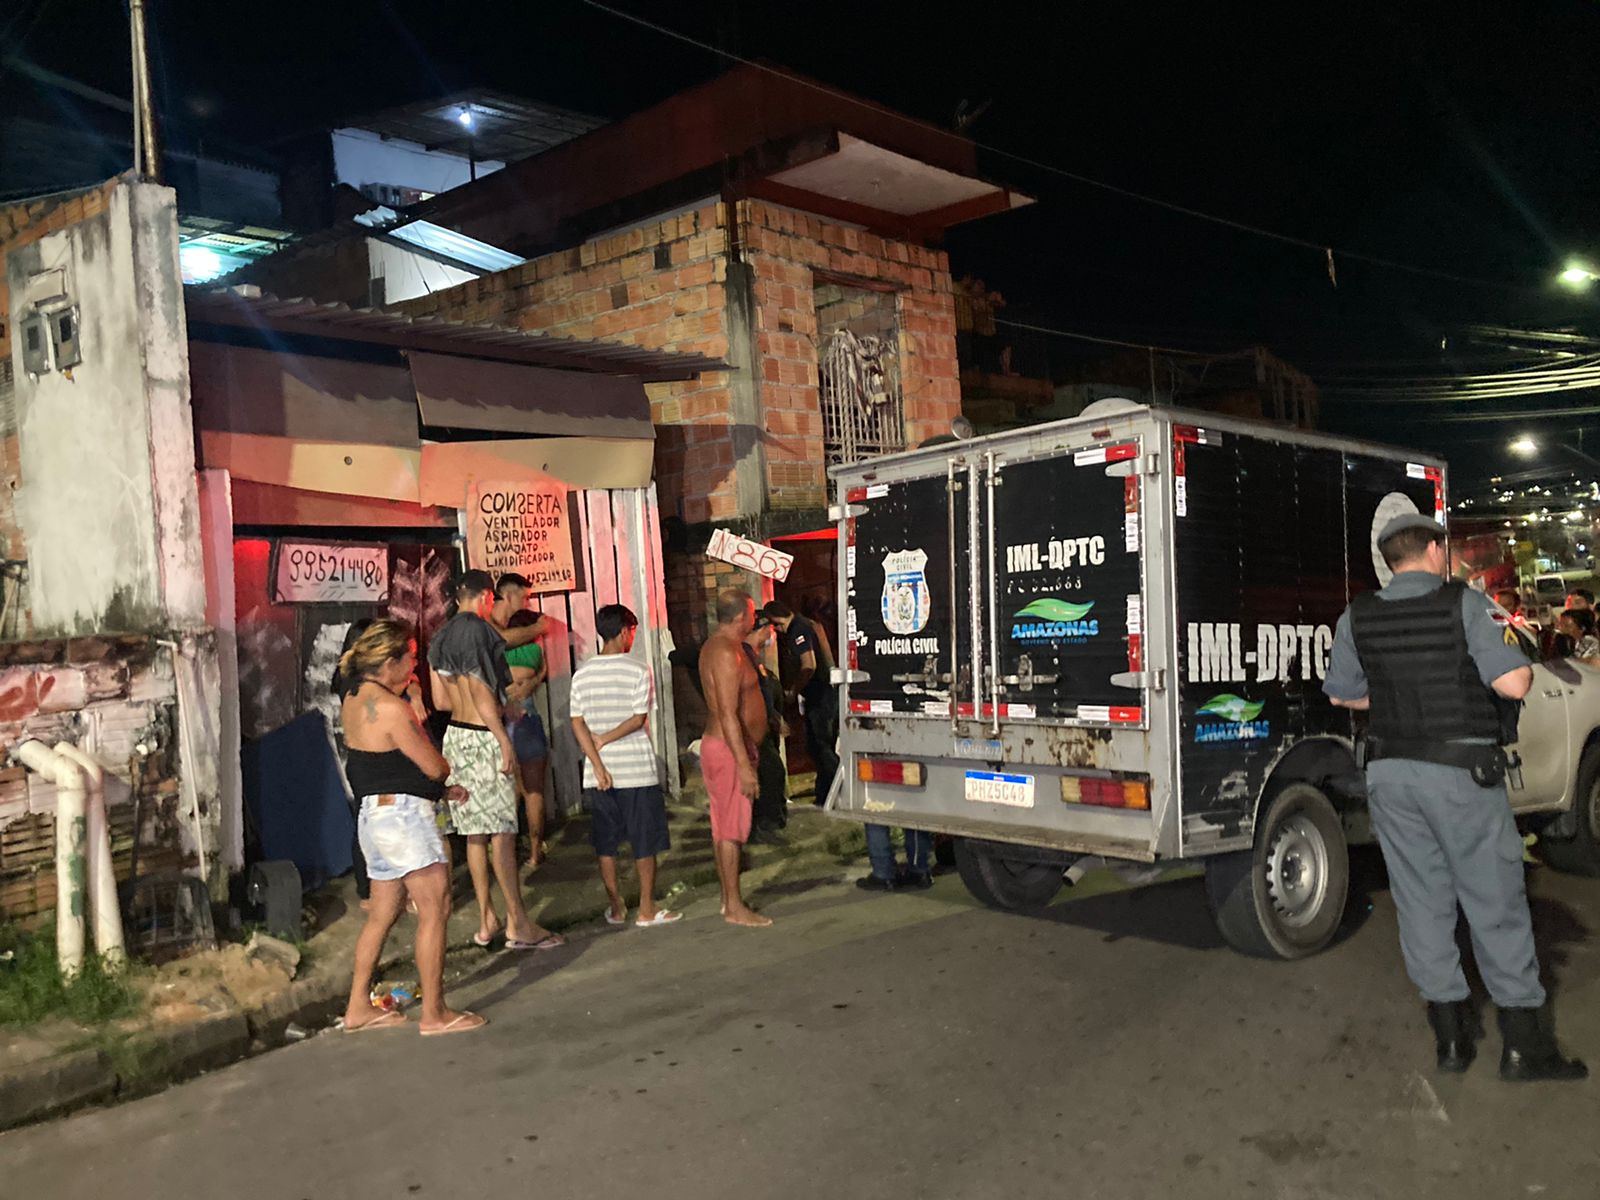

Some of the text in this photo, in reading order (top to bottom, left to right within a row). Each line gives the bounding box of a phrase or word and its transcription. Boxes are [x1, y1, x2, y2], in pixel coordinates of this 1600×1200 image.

[480, 492, 562, 515] CONSERTA
[482, 516, 560, 529] VENTILADOR
[485, 530, 548, 543] ASPIRADOR
[486, 552, 555, 568] LIKIDIFICADOR
[1006, 536, 1105, 573] IML-DPTC
[289, 549, 383, 588] 995214480
[1011, 619, 1099, 639] AMAZONAS
[875, 637, 940, 655] POLÍCIA CIVIL
[1187, 622, 1334, 683] IML-DPTC
[1194, 720, 1270, 742] AMAZONAS
[971, 780, 1025, 803] PHZ5C48
